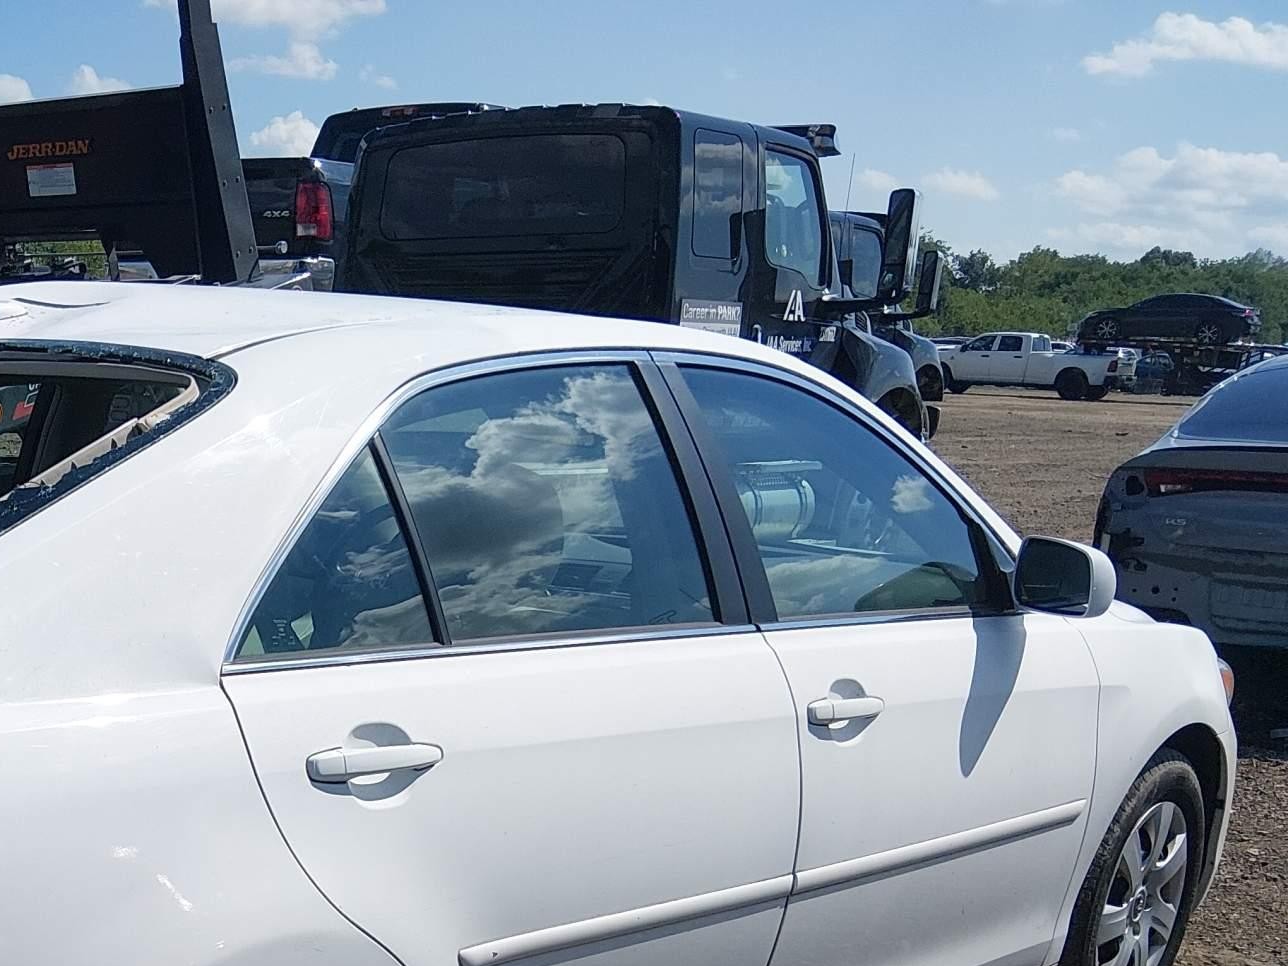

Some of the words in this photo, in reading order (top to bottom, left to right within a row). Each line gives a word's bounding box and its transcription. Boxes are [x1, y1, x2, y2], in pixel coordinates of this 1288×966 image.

[683, 303, 707, 320] Career
[709, 305, 716, 320] in
[717, 305, 741, 321] PARK?
